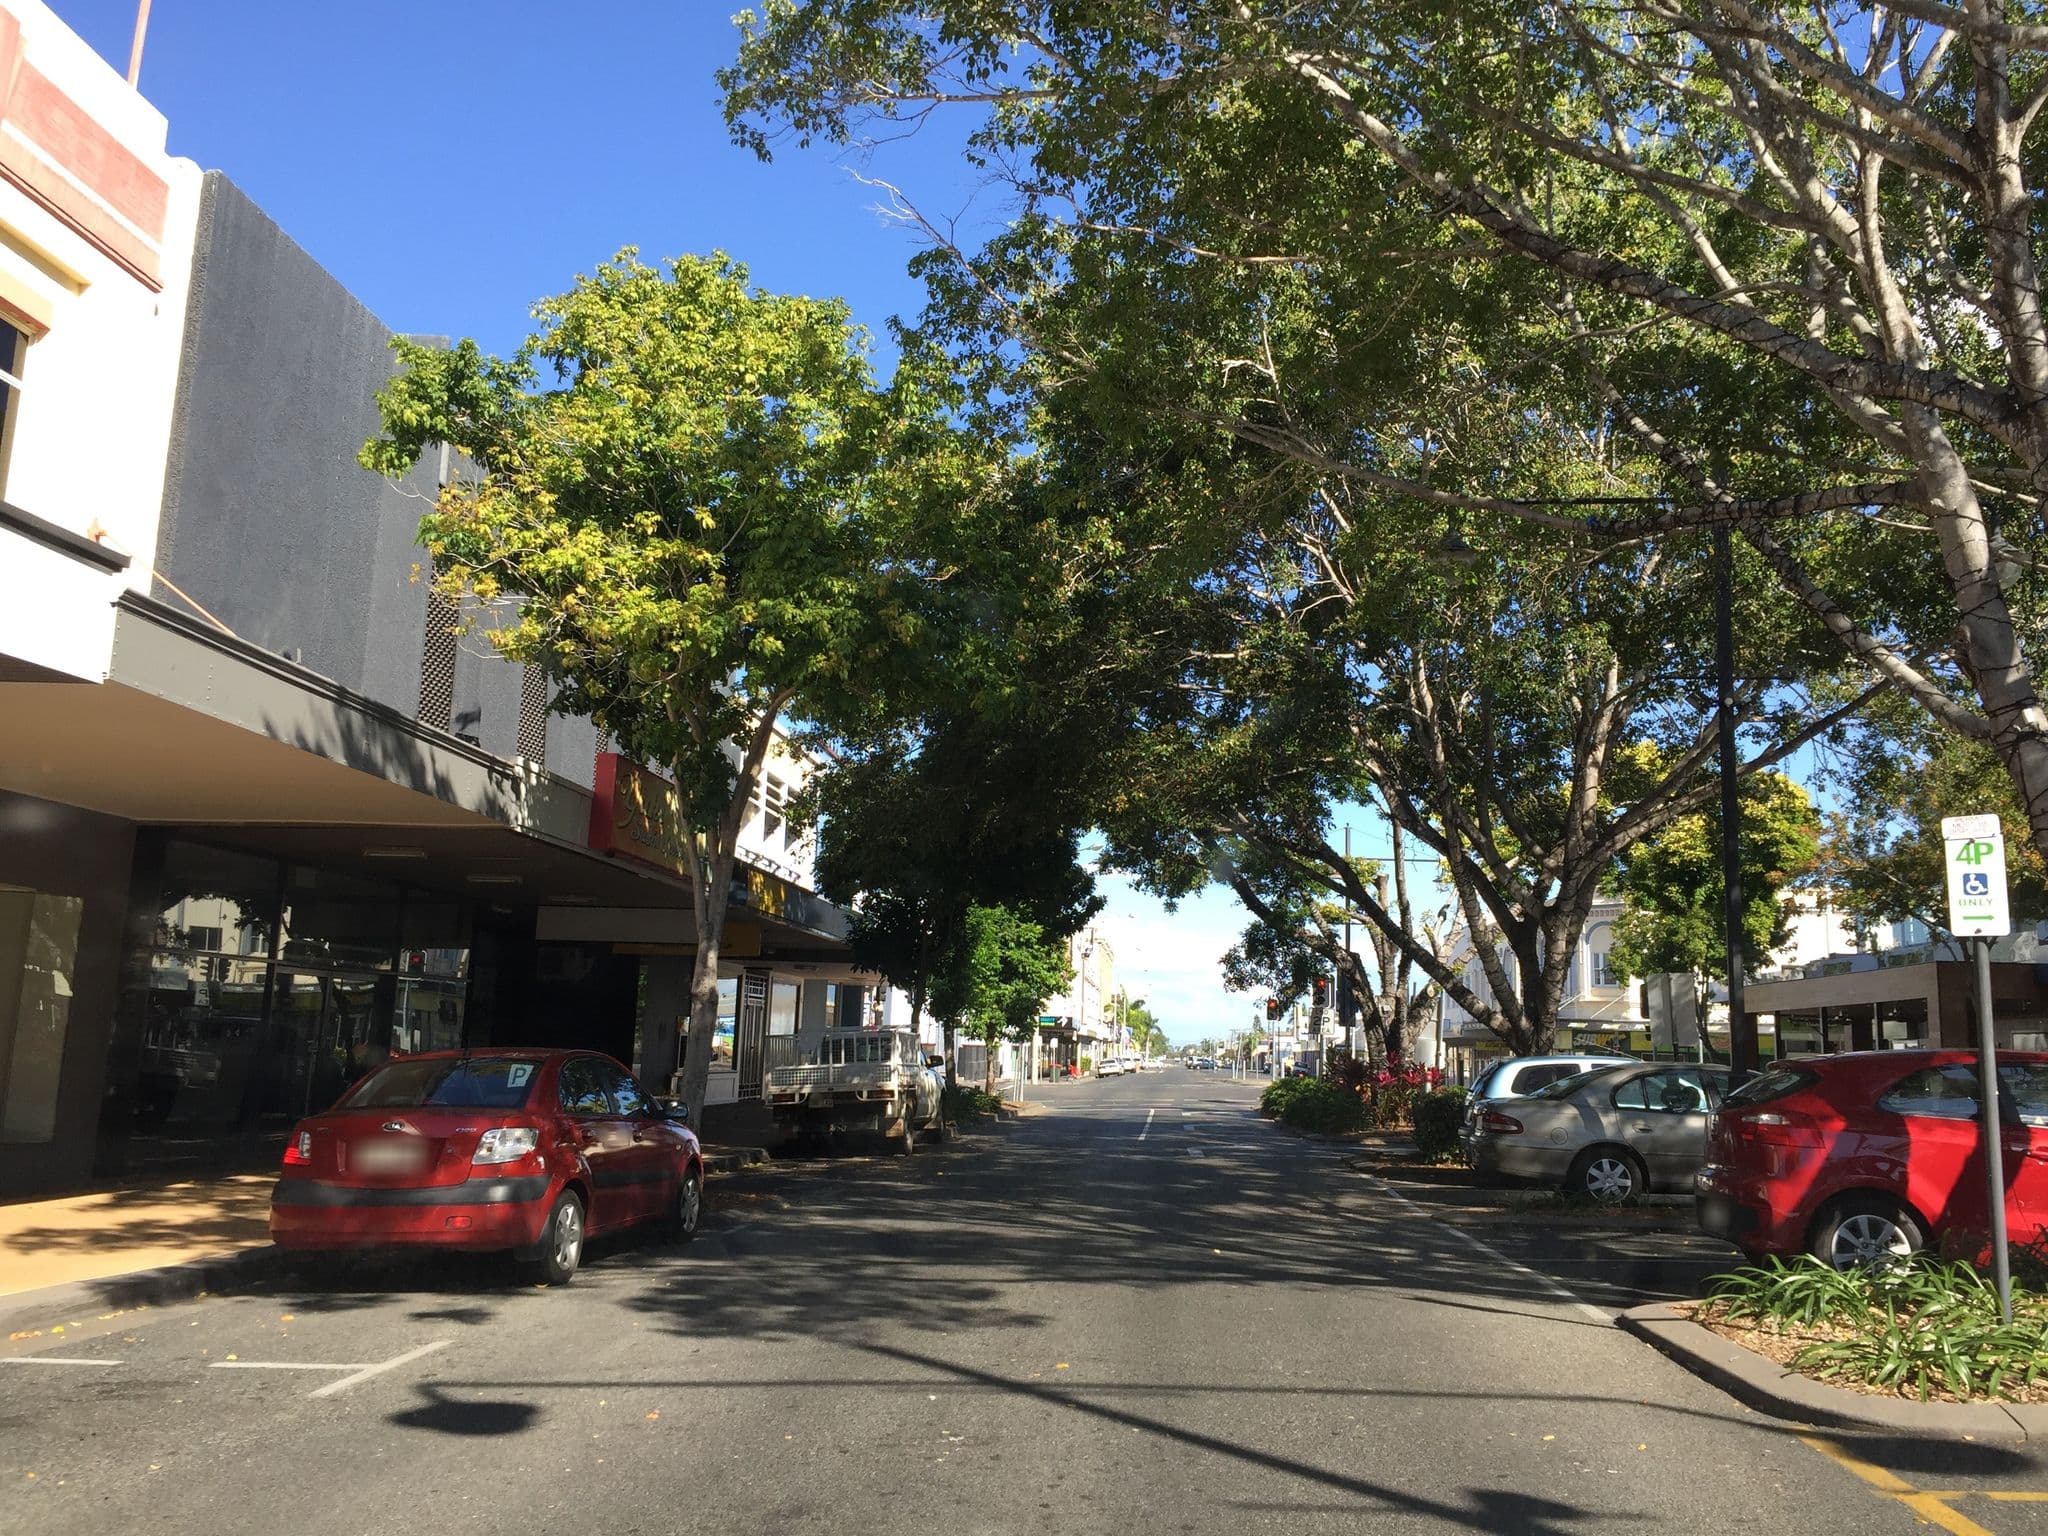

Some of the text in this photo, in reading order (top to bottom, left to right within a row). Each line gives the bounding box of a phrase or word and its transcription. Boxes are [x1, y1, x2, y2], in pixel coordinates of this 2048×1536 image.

[1955, 842, 1994, 865] 4P
[1958, 898, 1993, 906] ONLY
[1313, 1016, 1331, 1026] 2P
[512, 1066, 527, 1085] P
